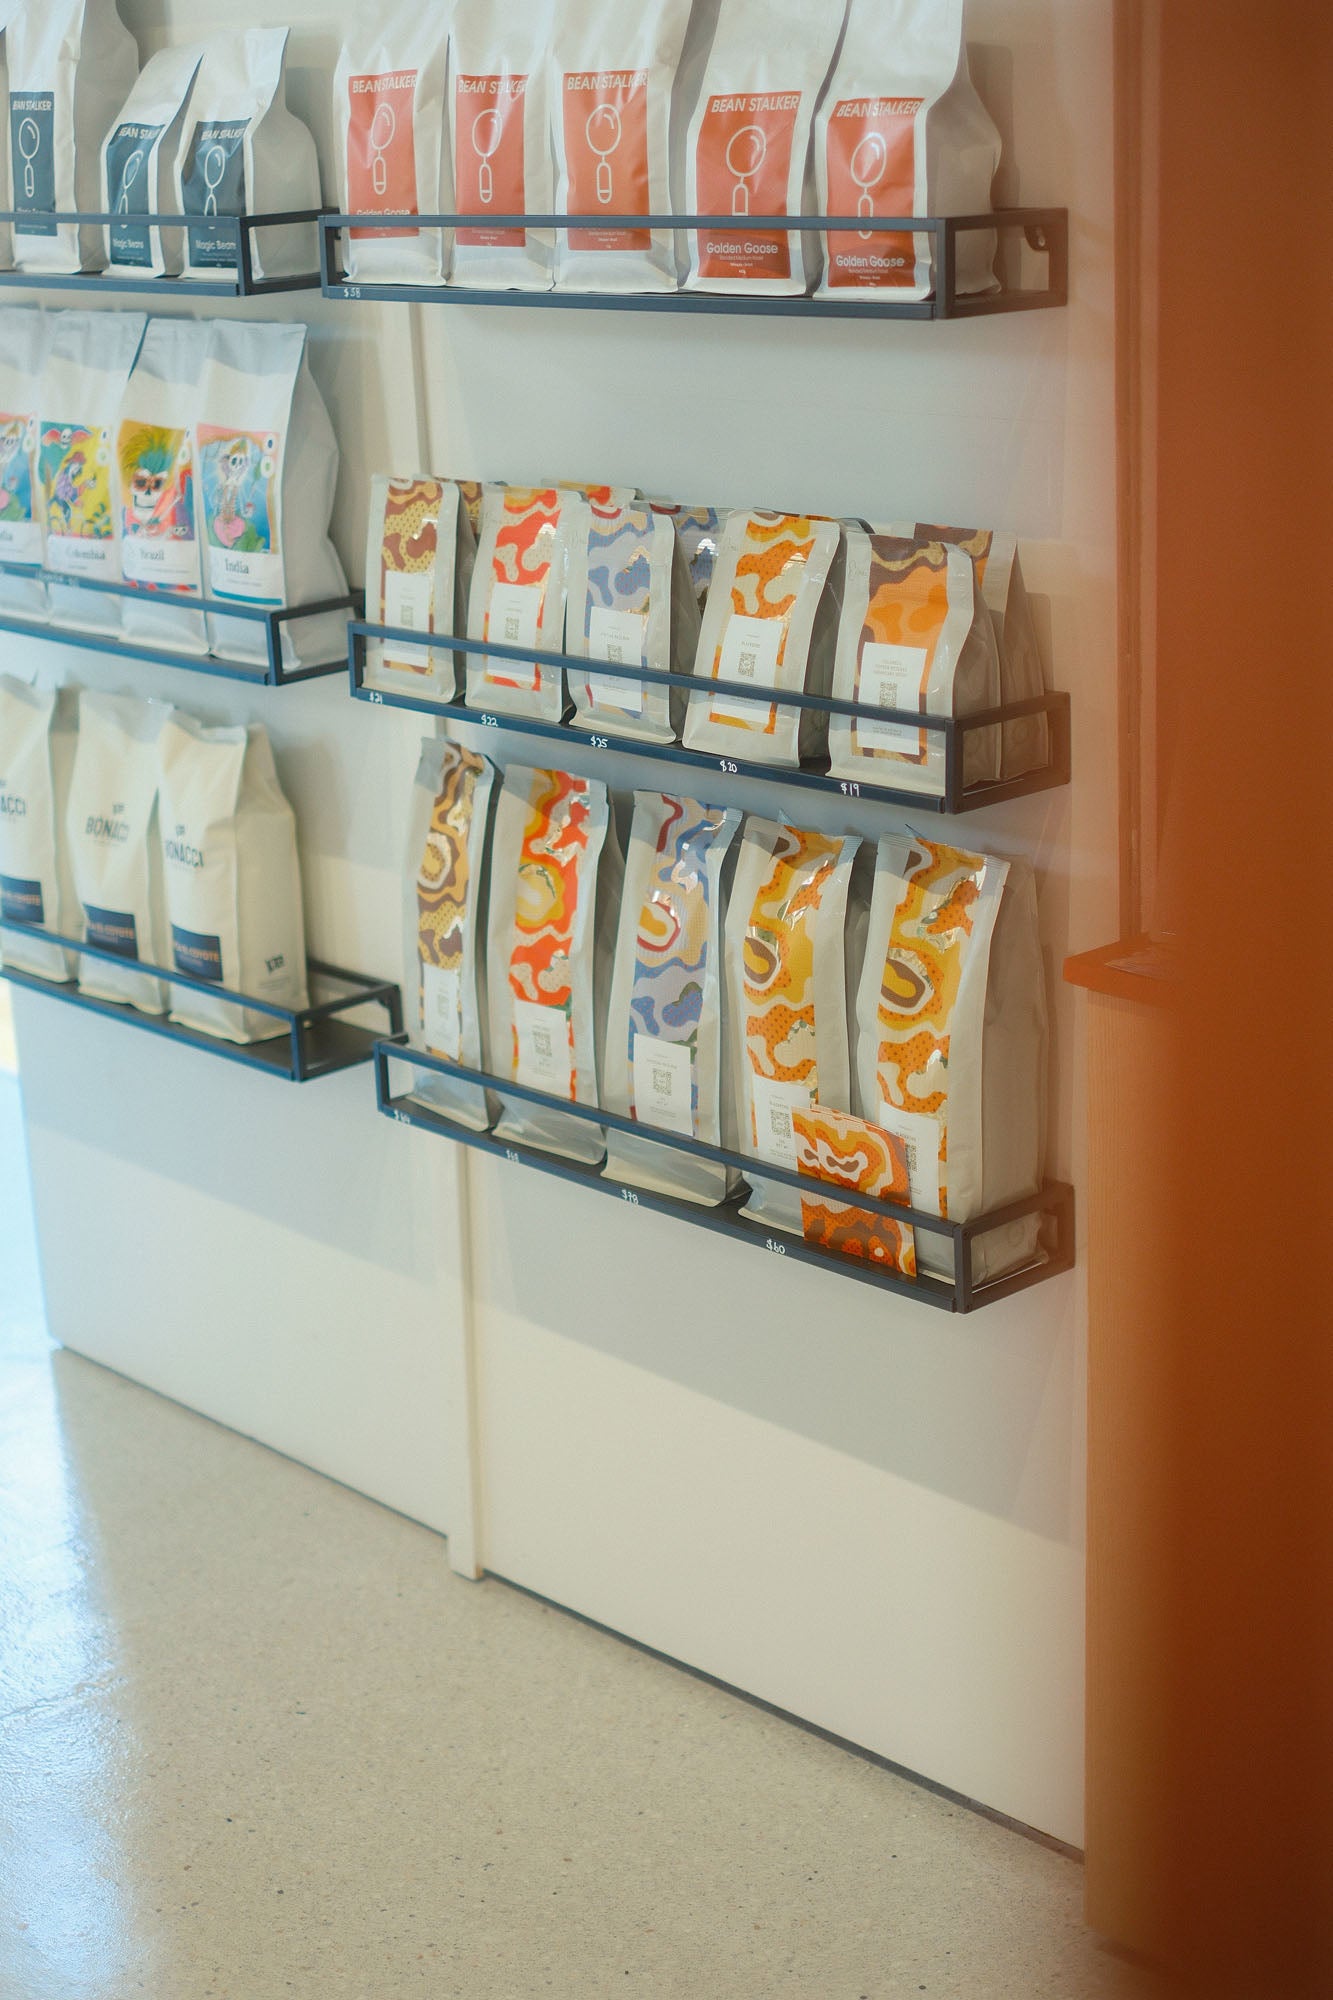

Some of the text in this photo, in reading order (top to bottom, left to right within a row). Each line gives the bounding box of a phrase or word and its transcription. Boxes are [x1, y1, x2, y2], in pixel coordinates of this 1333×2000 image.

[352, 79, 380, 94] BEAN
[459, 79, 487, 94] BEAN
[567, 76, 600, 90] BEAN
[711, 95, 800, 113] BEAN STALKER
[837, 100, 922, 118] BEAN STALKER
[706, 241, 778, 254] Golden Goose
[836, 255, 905, 267] Golden Goose
[224, 557, 249, 574] India
[480, 713, 499, 727] $22
[589, 735, 609, 748] $25
[719, 759, 738, 774] $20
[840, 782, 860, 798] $19
[765, 1238, 787, 1256] $60
